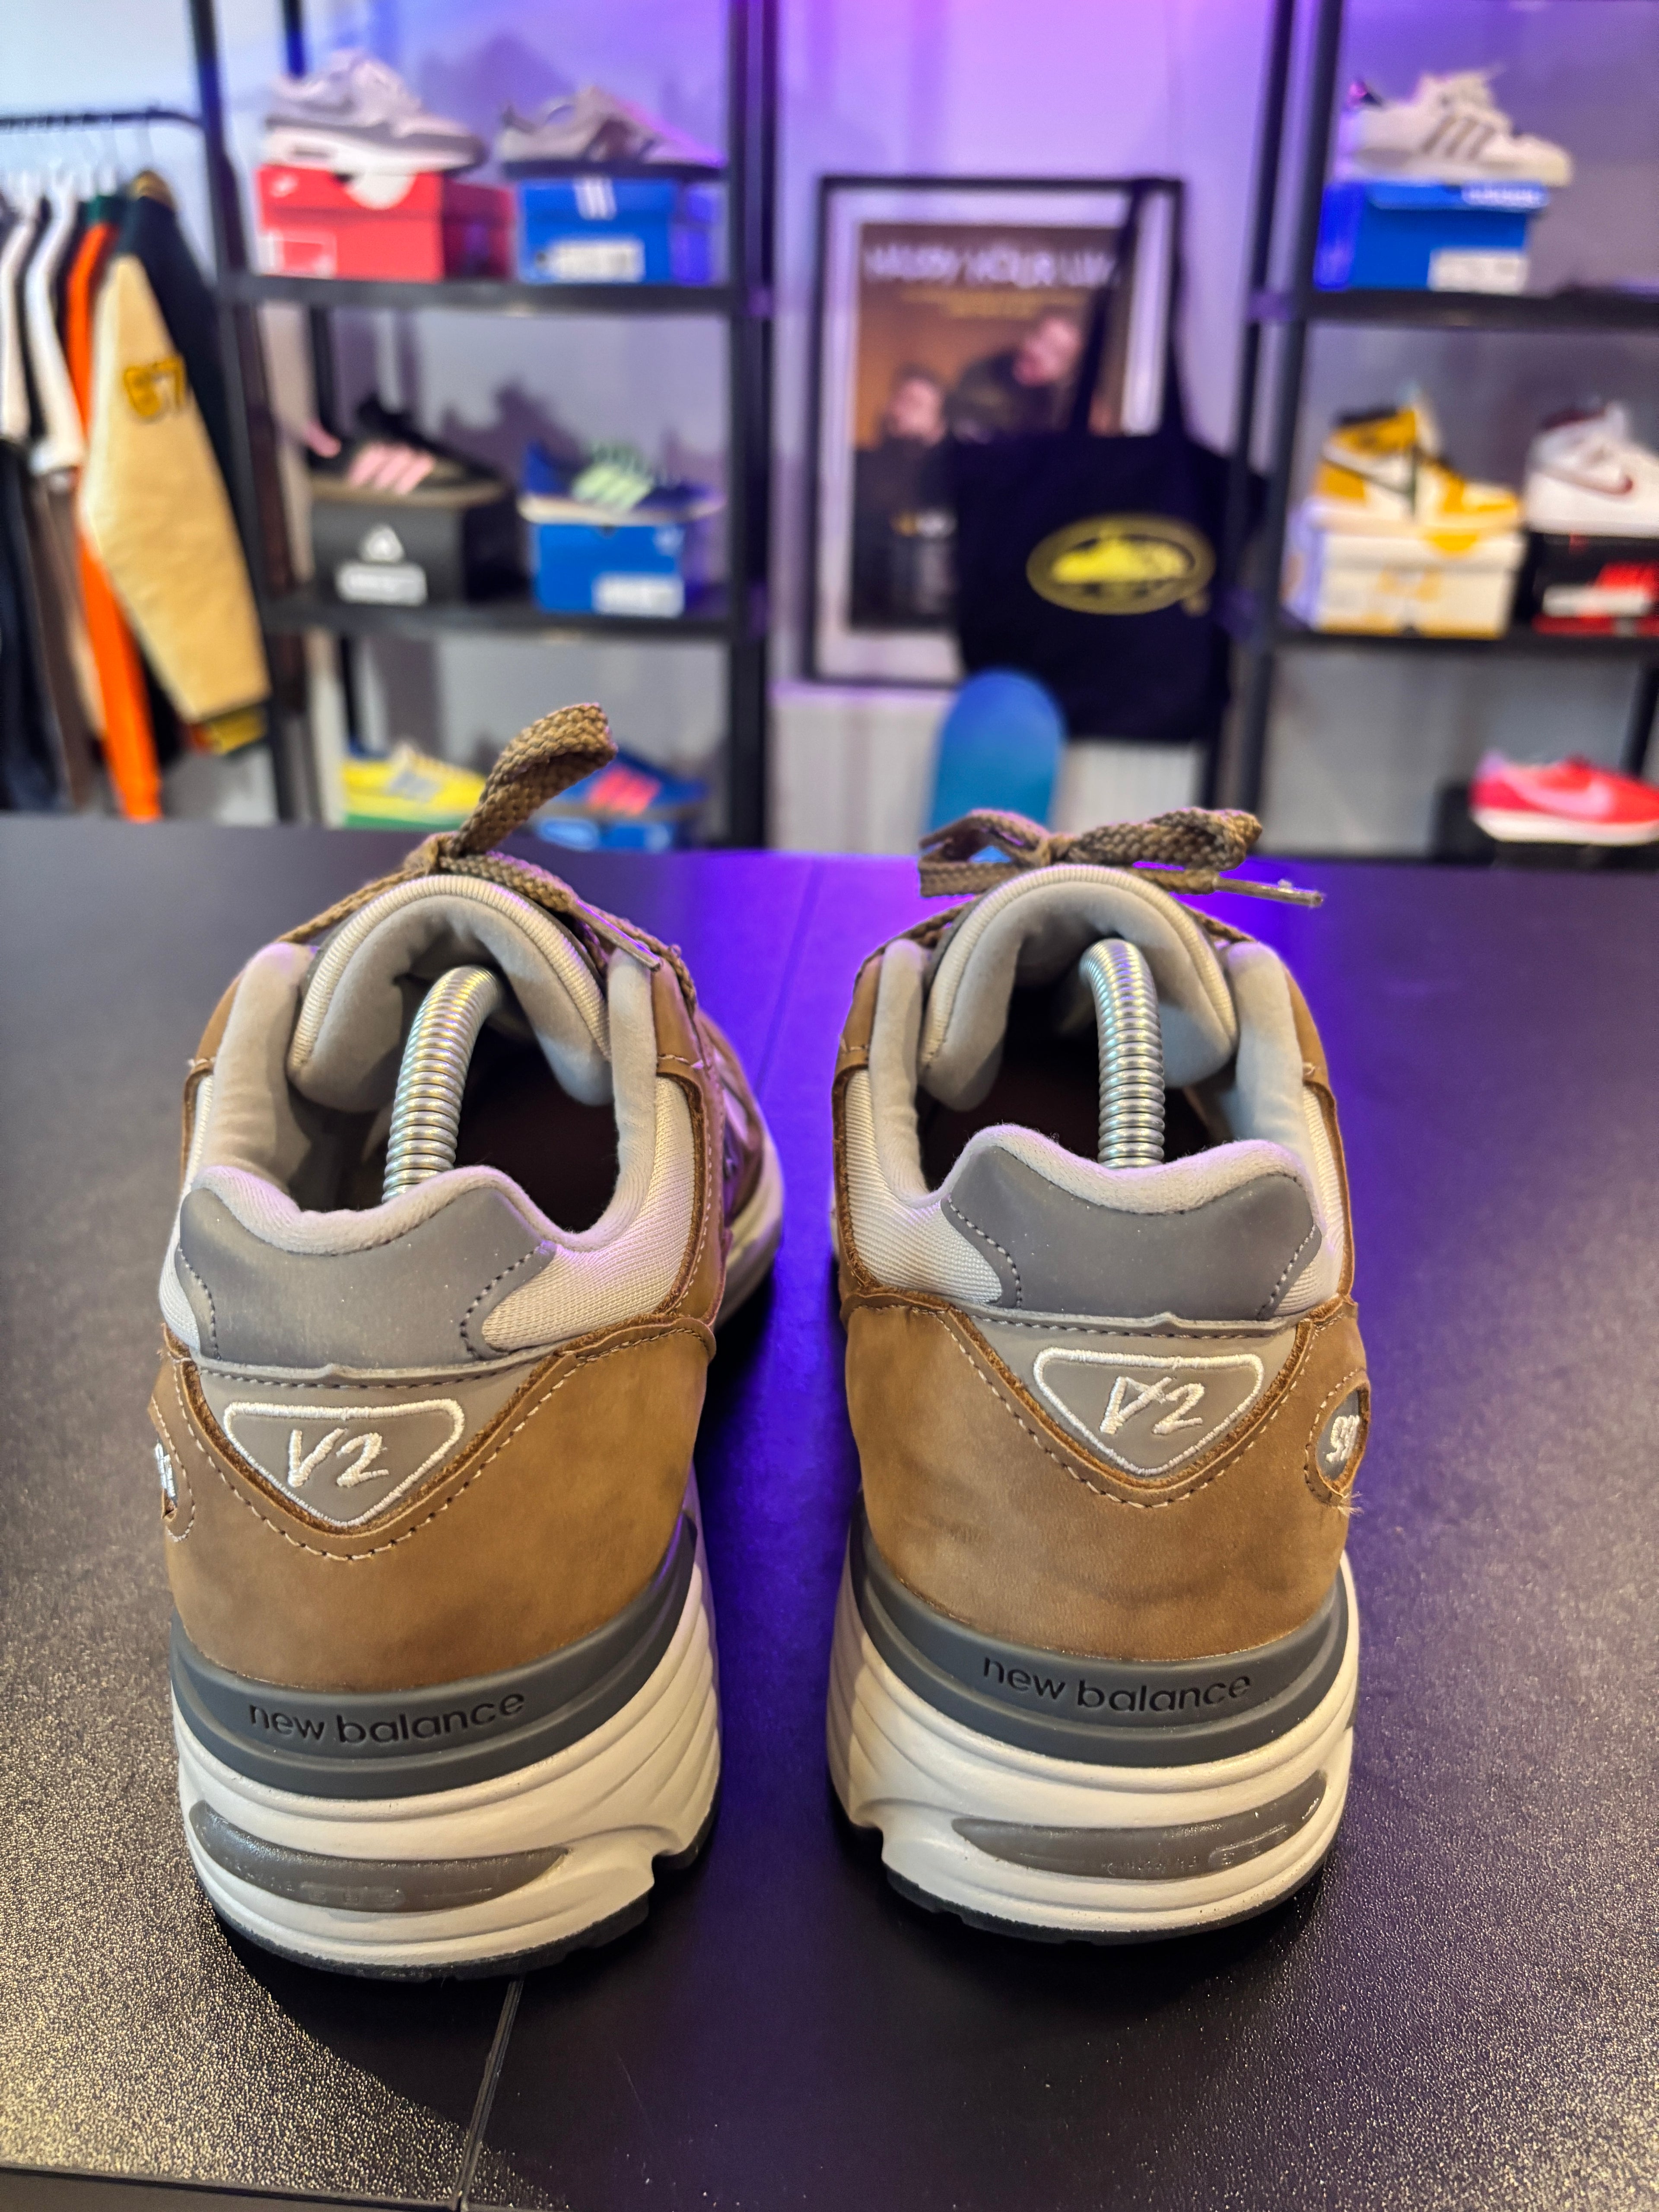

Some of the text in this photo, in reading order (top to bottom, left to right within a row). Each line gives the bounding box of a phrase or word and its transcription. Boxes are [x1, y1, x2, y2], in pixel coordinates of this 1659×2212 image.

[1099, 1376, 1205, 1434] V2
[287, 1428, 389, 1487] V2
[983, 1657, 1250, 1711] new balance
[251, 1693, 524, 1743] new balance
